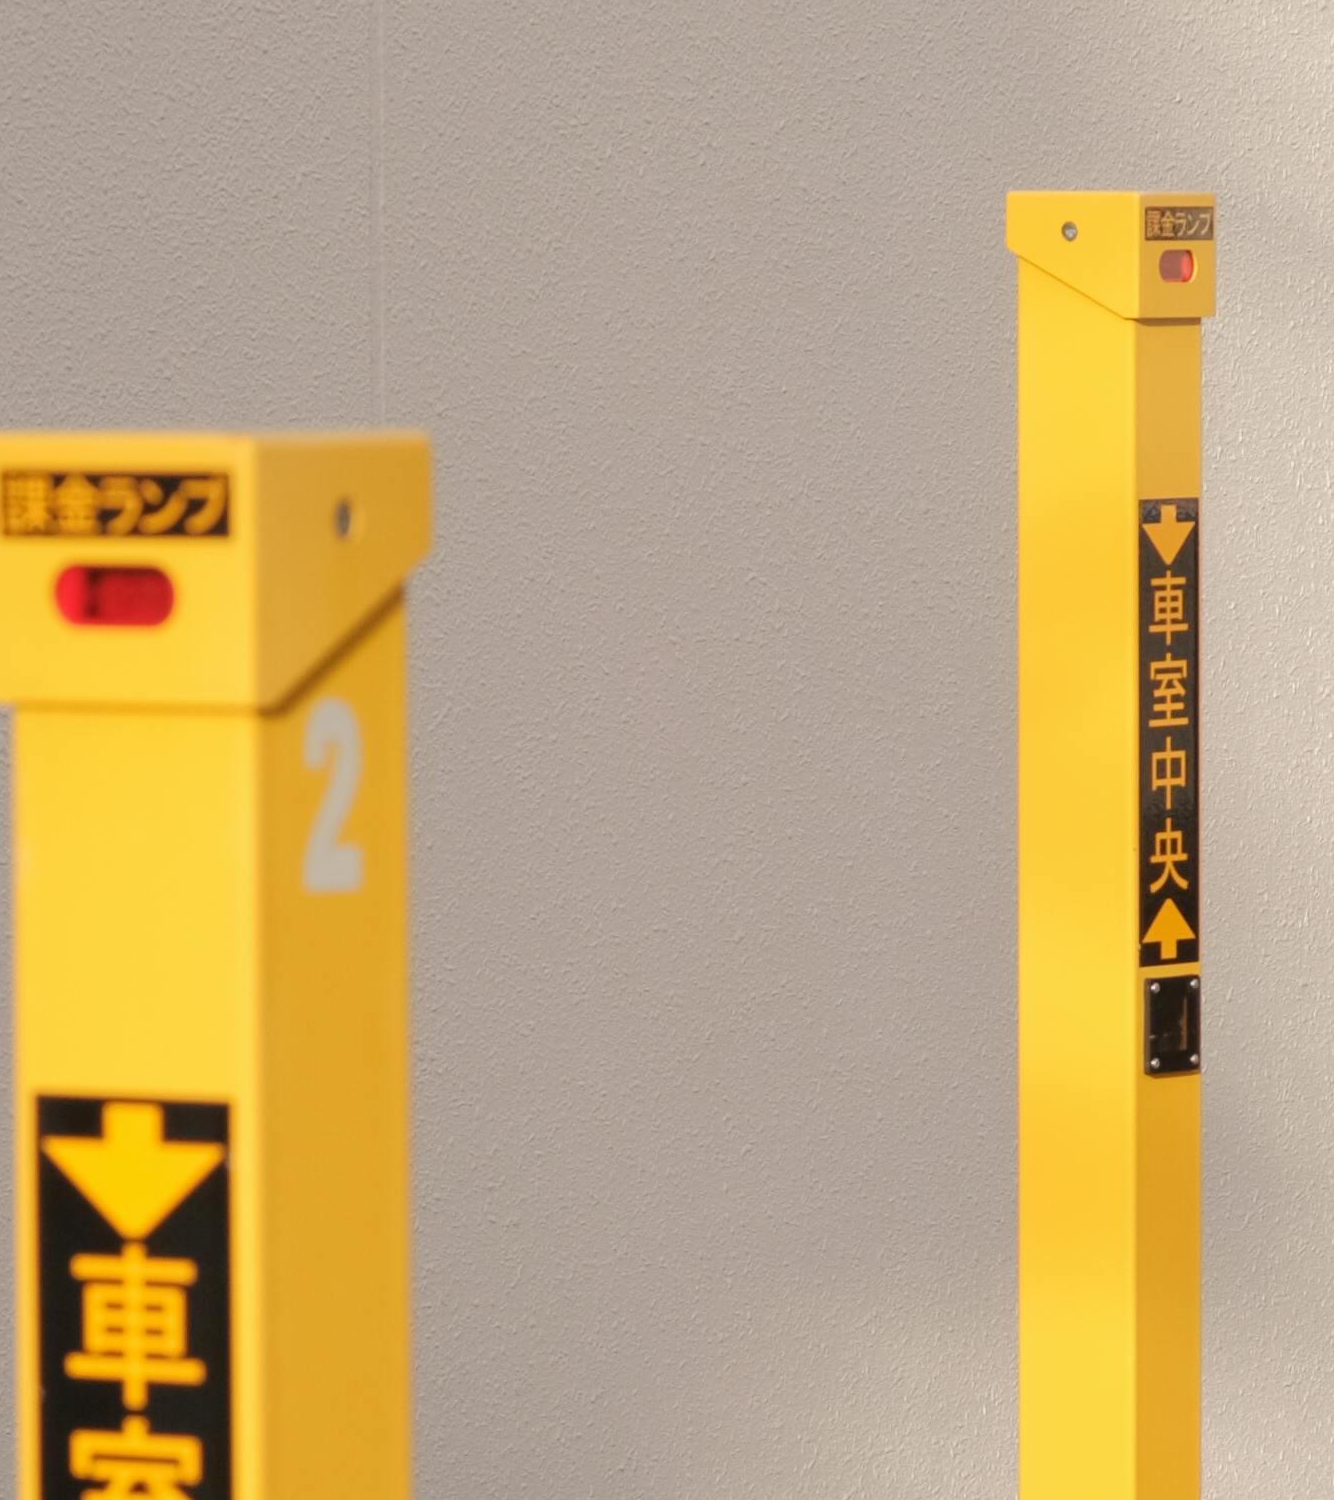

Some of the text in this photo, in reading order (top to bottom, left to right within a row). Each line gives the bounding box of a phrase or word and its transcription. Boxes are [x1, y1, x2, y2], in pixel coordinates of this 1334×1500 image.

[300, 695, 364, 895] 2
[1148, 570, 1190, 895] 車室中央
